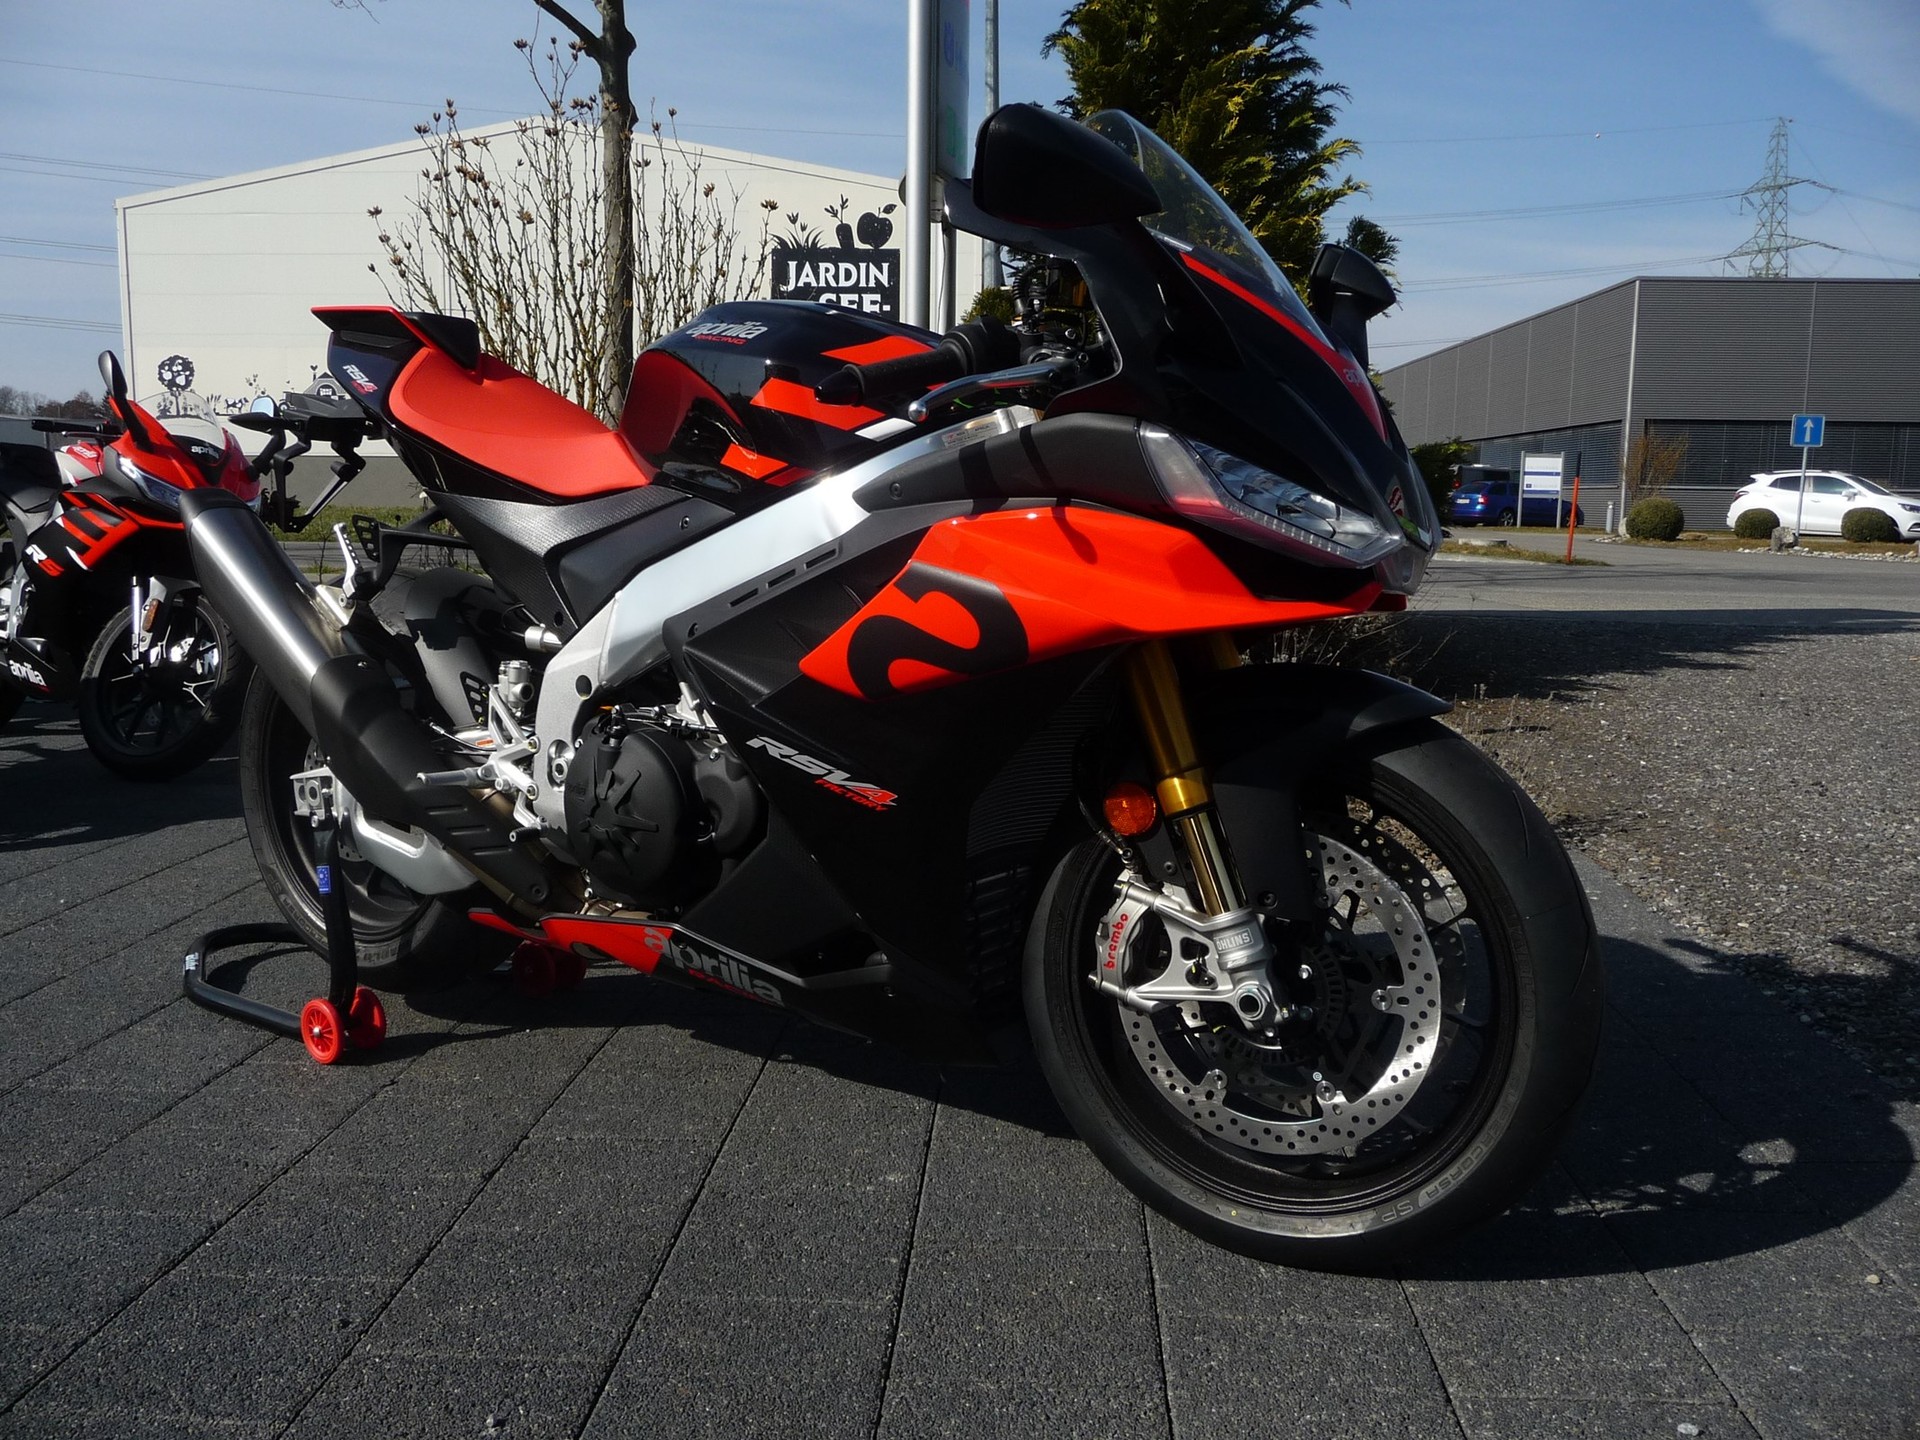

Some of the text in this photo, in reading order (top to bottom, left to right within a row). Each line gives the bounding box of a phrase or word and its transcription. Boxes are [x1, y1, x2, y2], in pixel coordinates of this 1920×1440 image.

[779, 261, 890, 292] JARDIN
[686, 321, 769, 339] aprilia
[9, 660, 47, 687] aprilia
[745, 735, 899, 806] RSV4
[1103, 913, 1129, 970] brembo
[643, 926, 786, 1008] aprilia
[1380, 1199, 1415, 1223] SP
